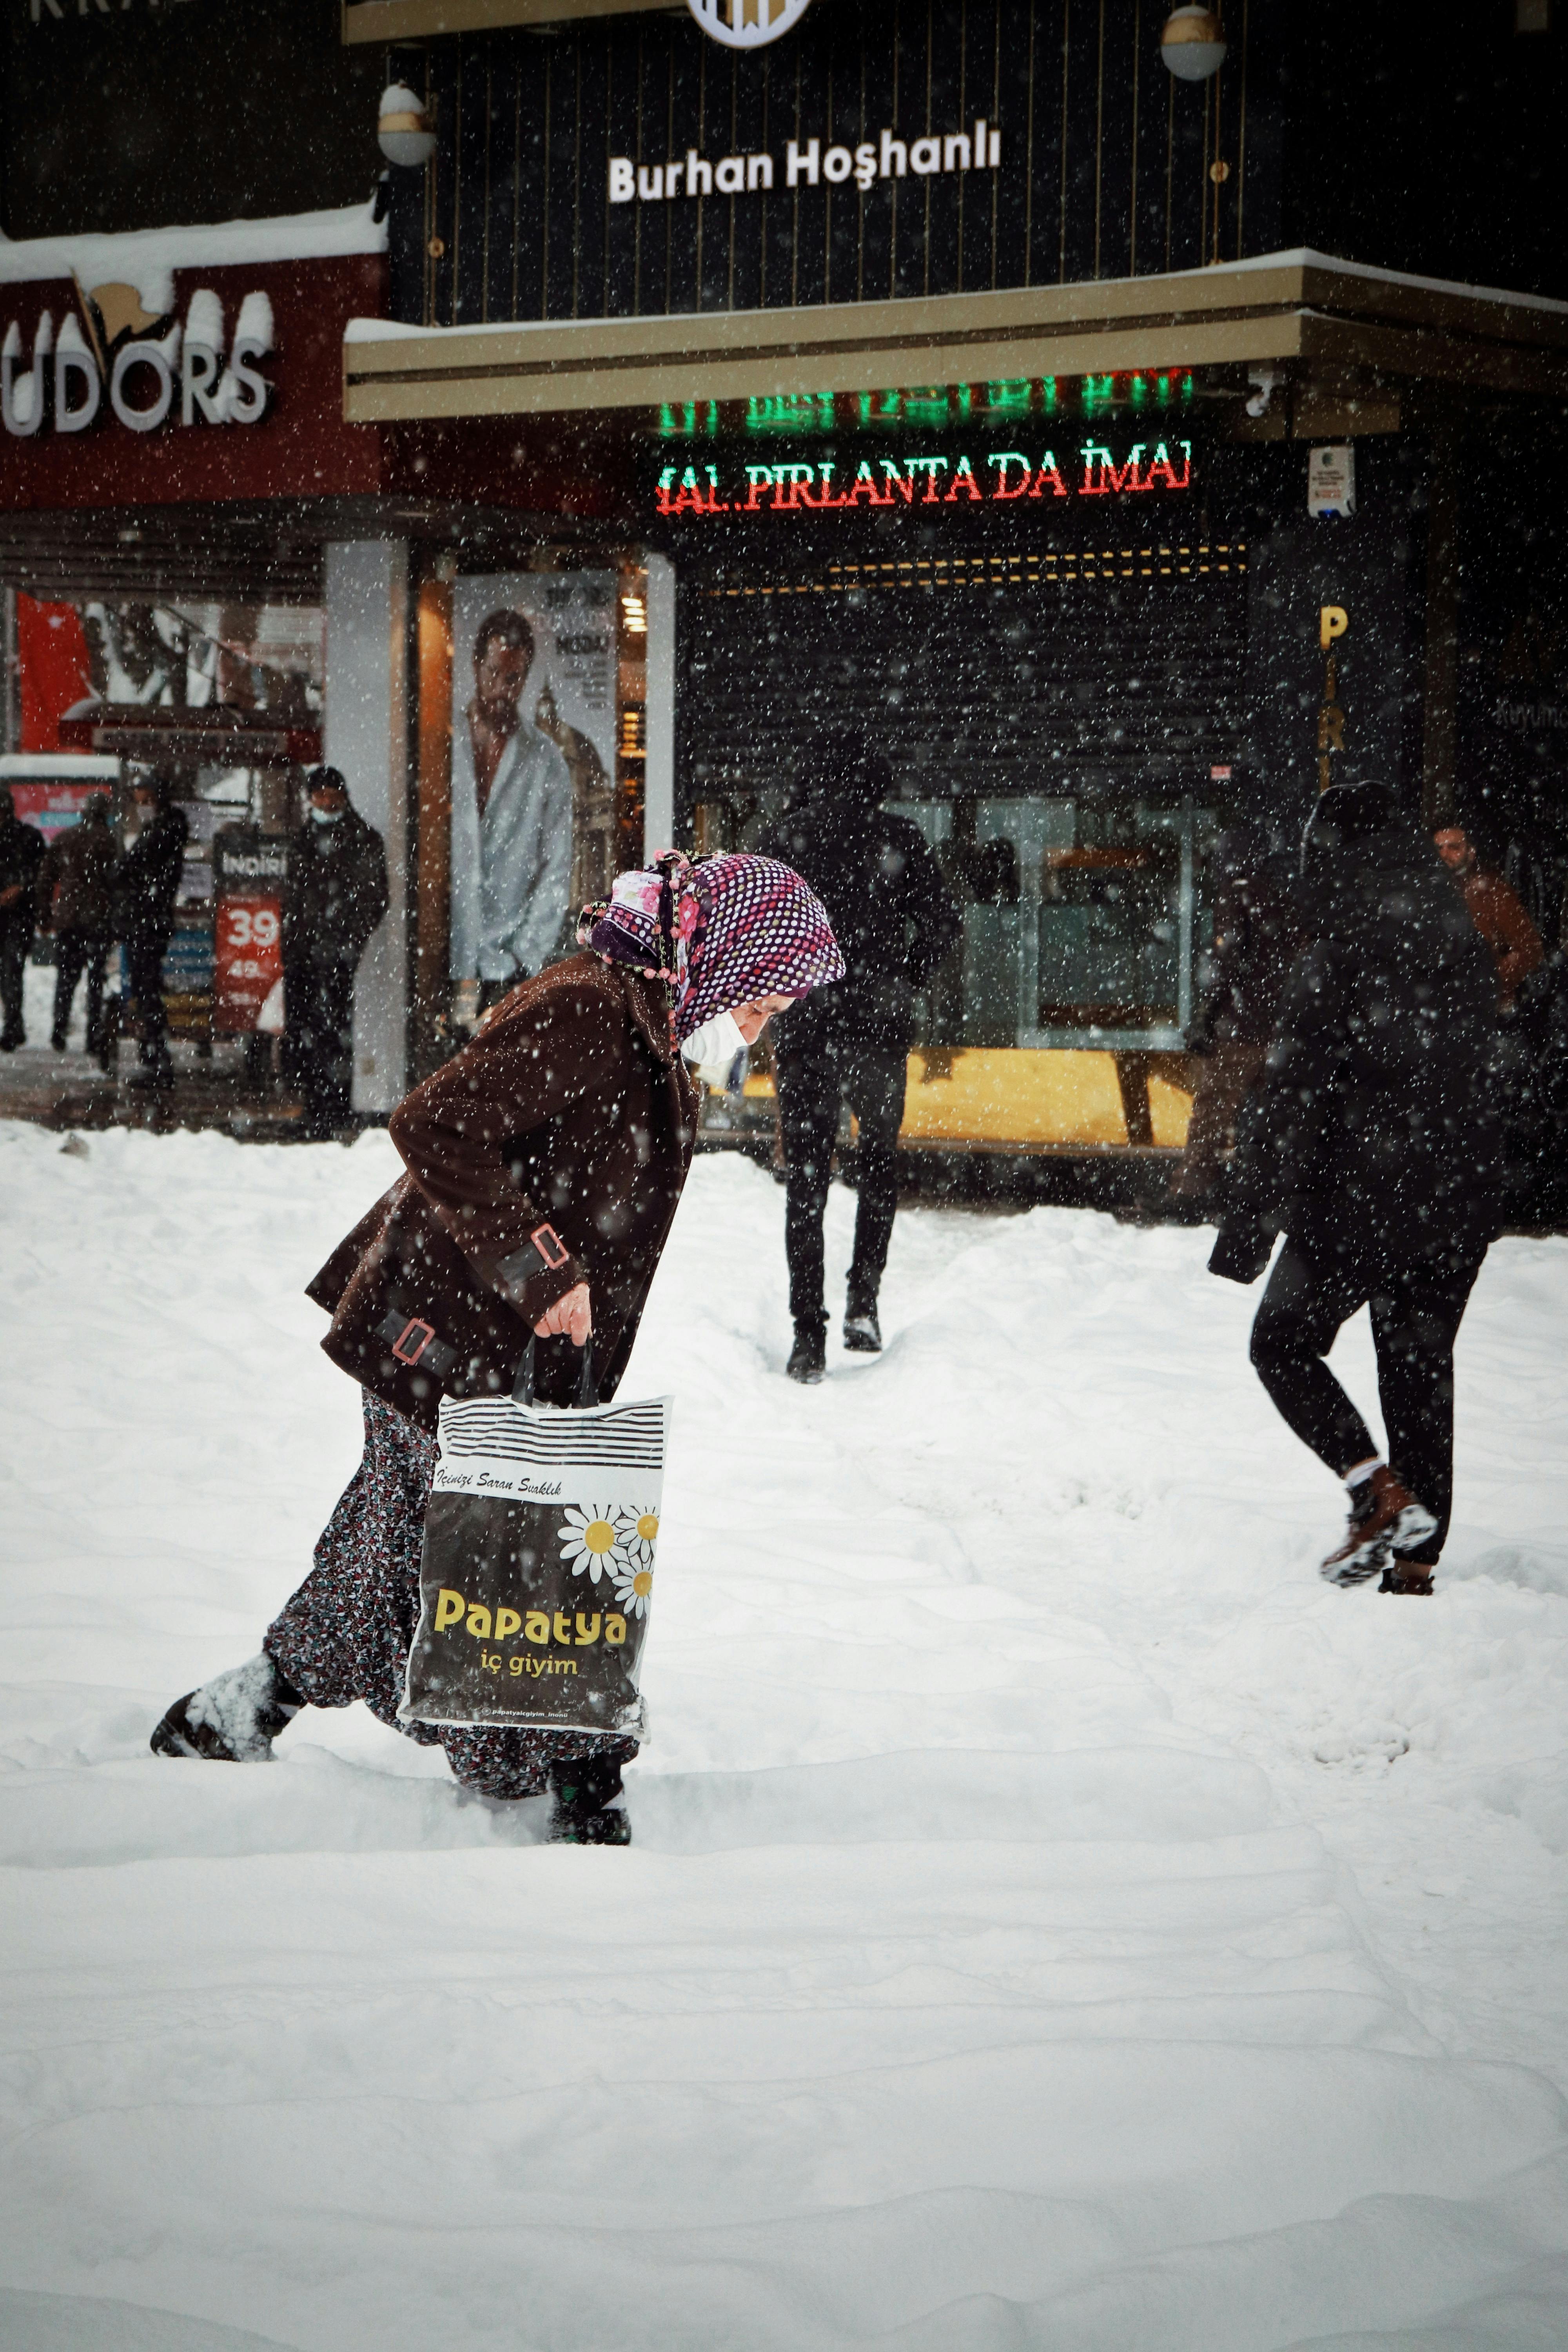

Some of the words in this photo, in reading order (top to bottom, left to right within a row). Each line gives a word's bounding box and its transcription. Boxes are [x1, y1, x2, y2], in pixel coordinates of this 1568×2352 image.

[608, 149, 773, 203] Burhan
[786, 120, 1001, 190] Hoşhanlı
[744, 456, 982, 509] PIRLANTA
[987, 451, 1067, 499] DA
[227, 909, 278, 947] 39
[437, 1466, 473, 1488] İçinizi
[476, 1472, 513, 1490] Saran
[434, 1588, 627, 1646] Papatya
[481, 1648, 502, 1675] iç
[509, 1652, 578, 1679] giyim
